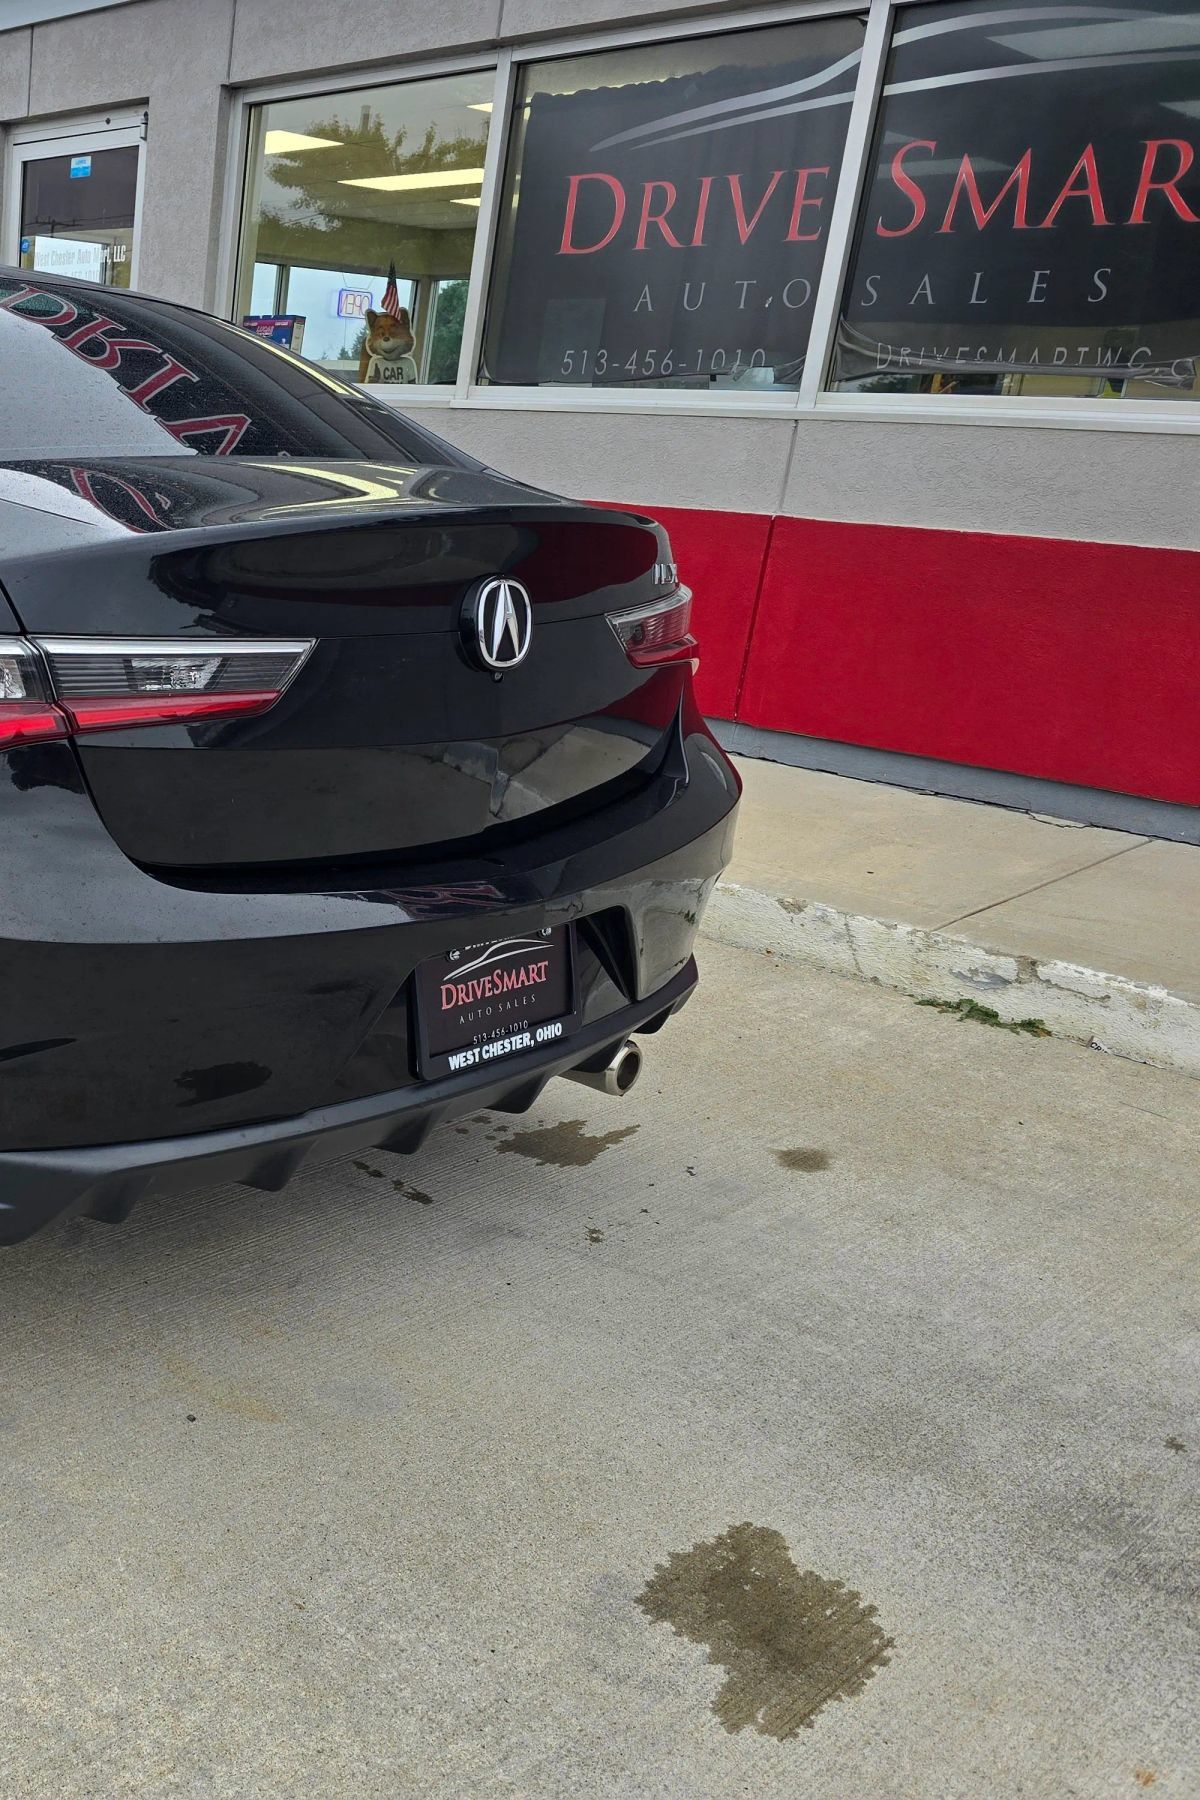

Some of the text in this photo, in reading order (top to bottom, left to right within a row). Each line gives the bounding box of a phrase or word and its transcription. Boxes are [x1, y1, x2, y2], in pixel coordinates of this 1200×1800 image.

[555, 166, 830, 255] DRIVE
[113, 245, 126, 262] LLC
[633, 268, 1111, 312] AUTO SALES
[383, 366, 404, 380] CAR
[460, 994, 536, 1025] AUTO SALES
[448, 1022, 562, 1071] WEST CHESTER, OHIO
[473, 1019, 529, 1045] 513-456-1010
